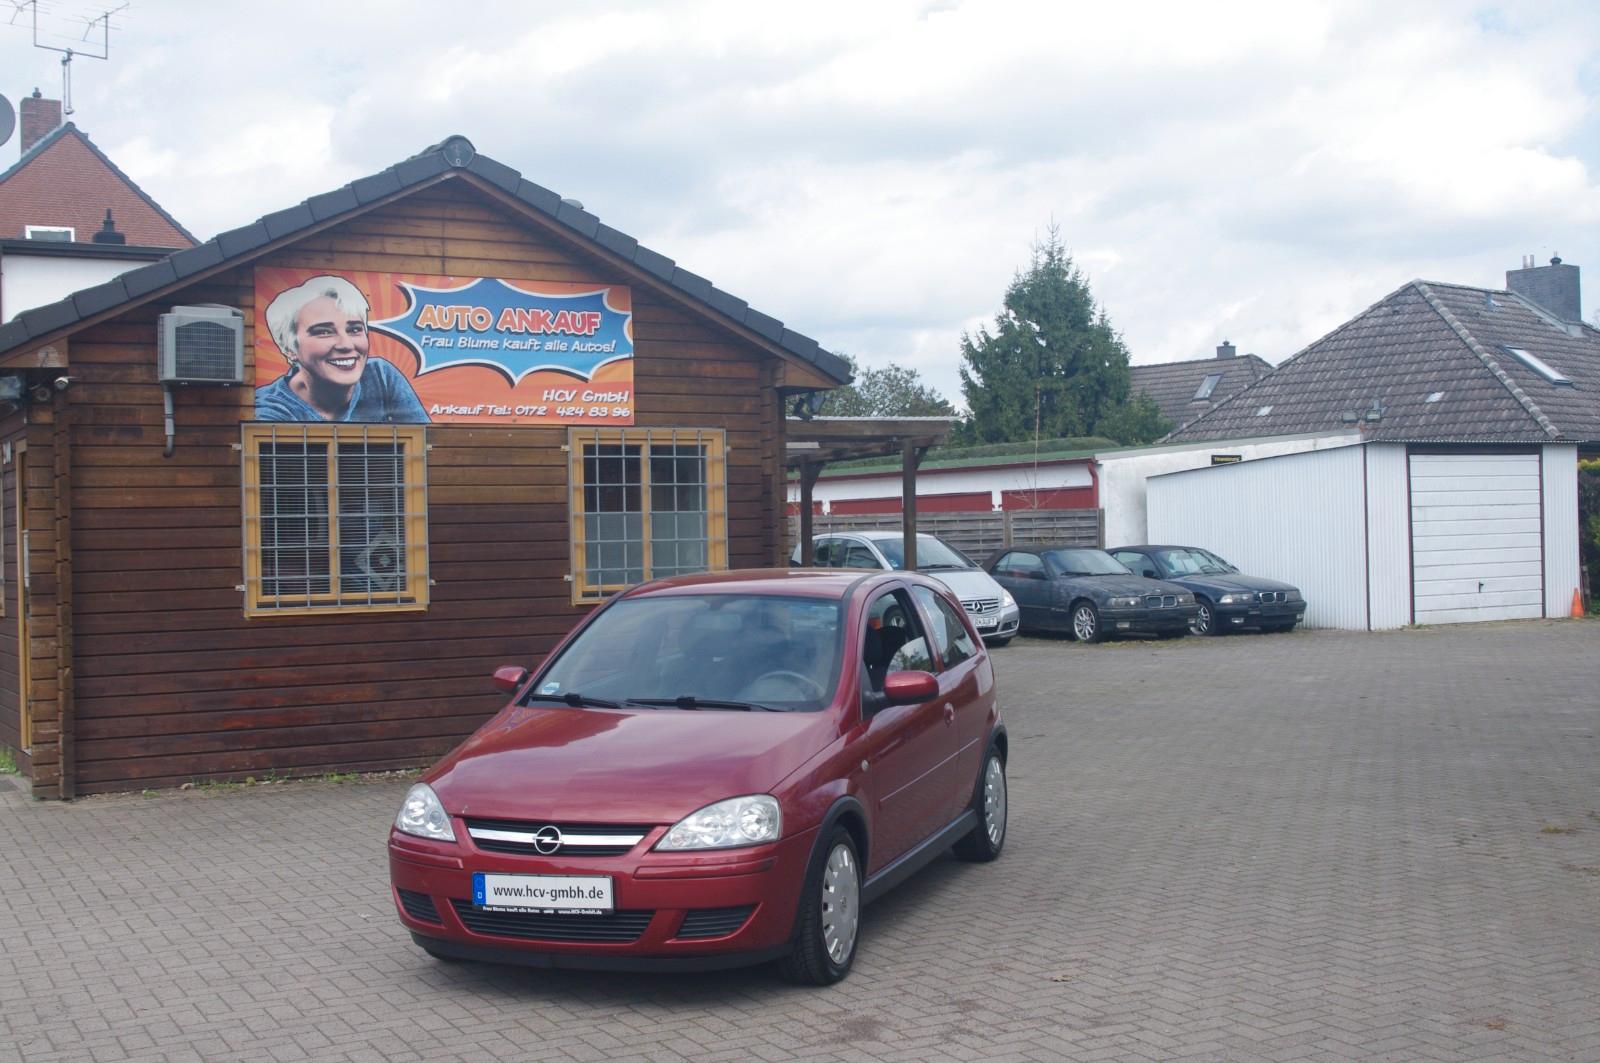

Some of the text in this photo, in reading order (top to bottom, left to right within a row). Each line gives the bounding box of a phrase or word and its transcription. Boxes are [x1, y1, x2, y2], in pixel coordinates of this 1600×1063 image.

[415, 304, 601, 335] AUTO ANKAUF
[421, 335, 617, 353] Frau Blume kauft alle Autos!
[542, 389, 630, 402] HCV GmbH
[514, 405, 548, 416] 0172
[556, 406, 585, 417] 424
[588, 406, 609, 417] 83
[611, 406, 631, 417] 96
[493, 885, 604, 902] www.hcv-gmbh.de
